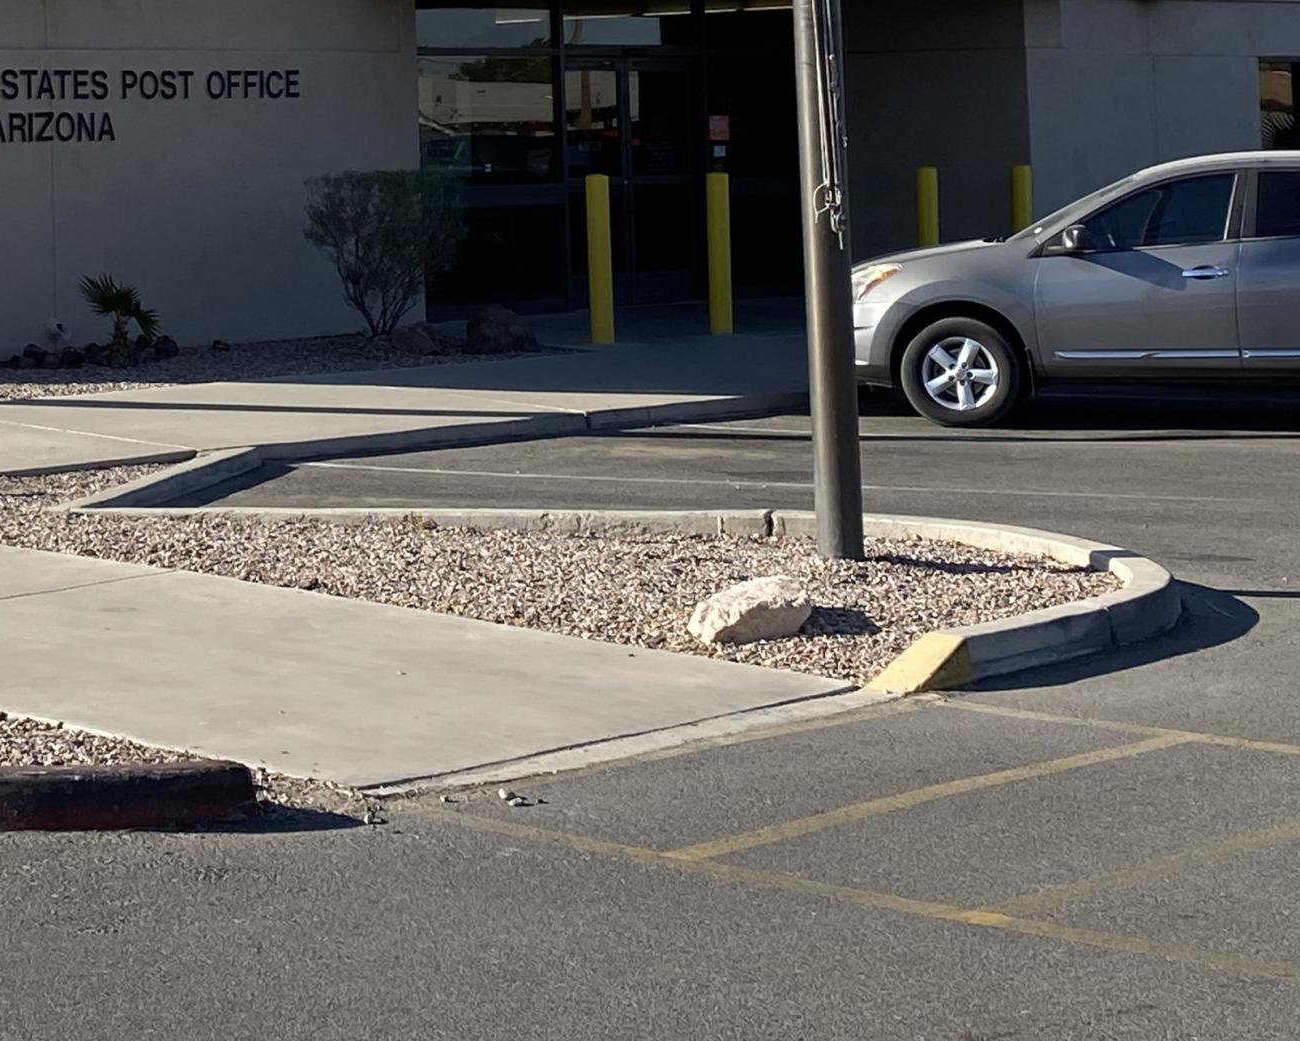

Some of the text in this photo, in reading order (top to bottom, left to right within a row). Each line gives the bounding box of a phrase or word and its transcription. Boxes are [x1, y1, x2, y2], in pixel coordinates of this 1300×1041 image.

[0, 69, 109, 100] STATES
[121, 70, 195, 100] POST
[206, 69, 301, 100] OFFICE
